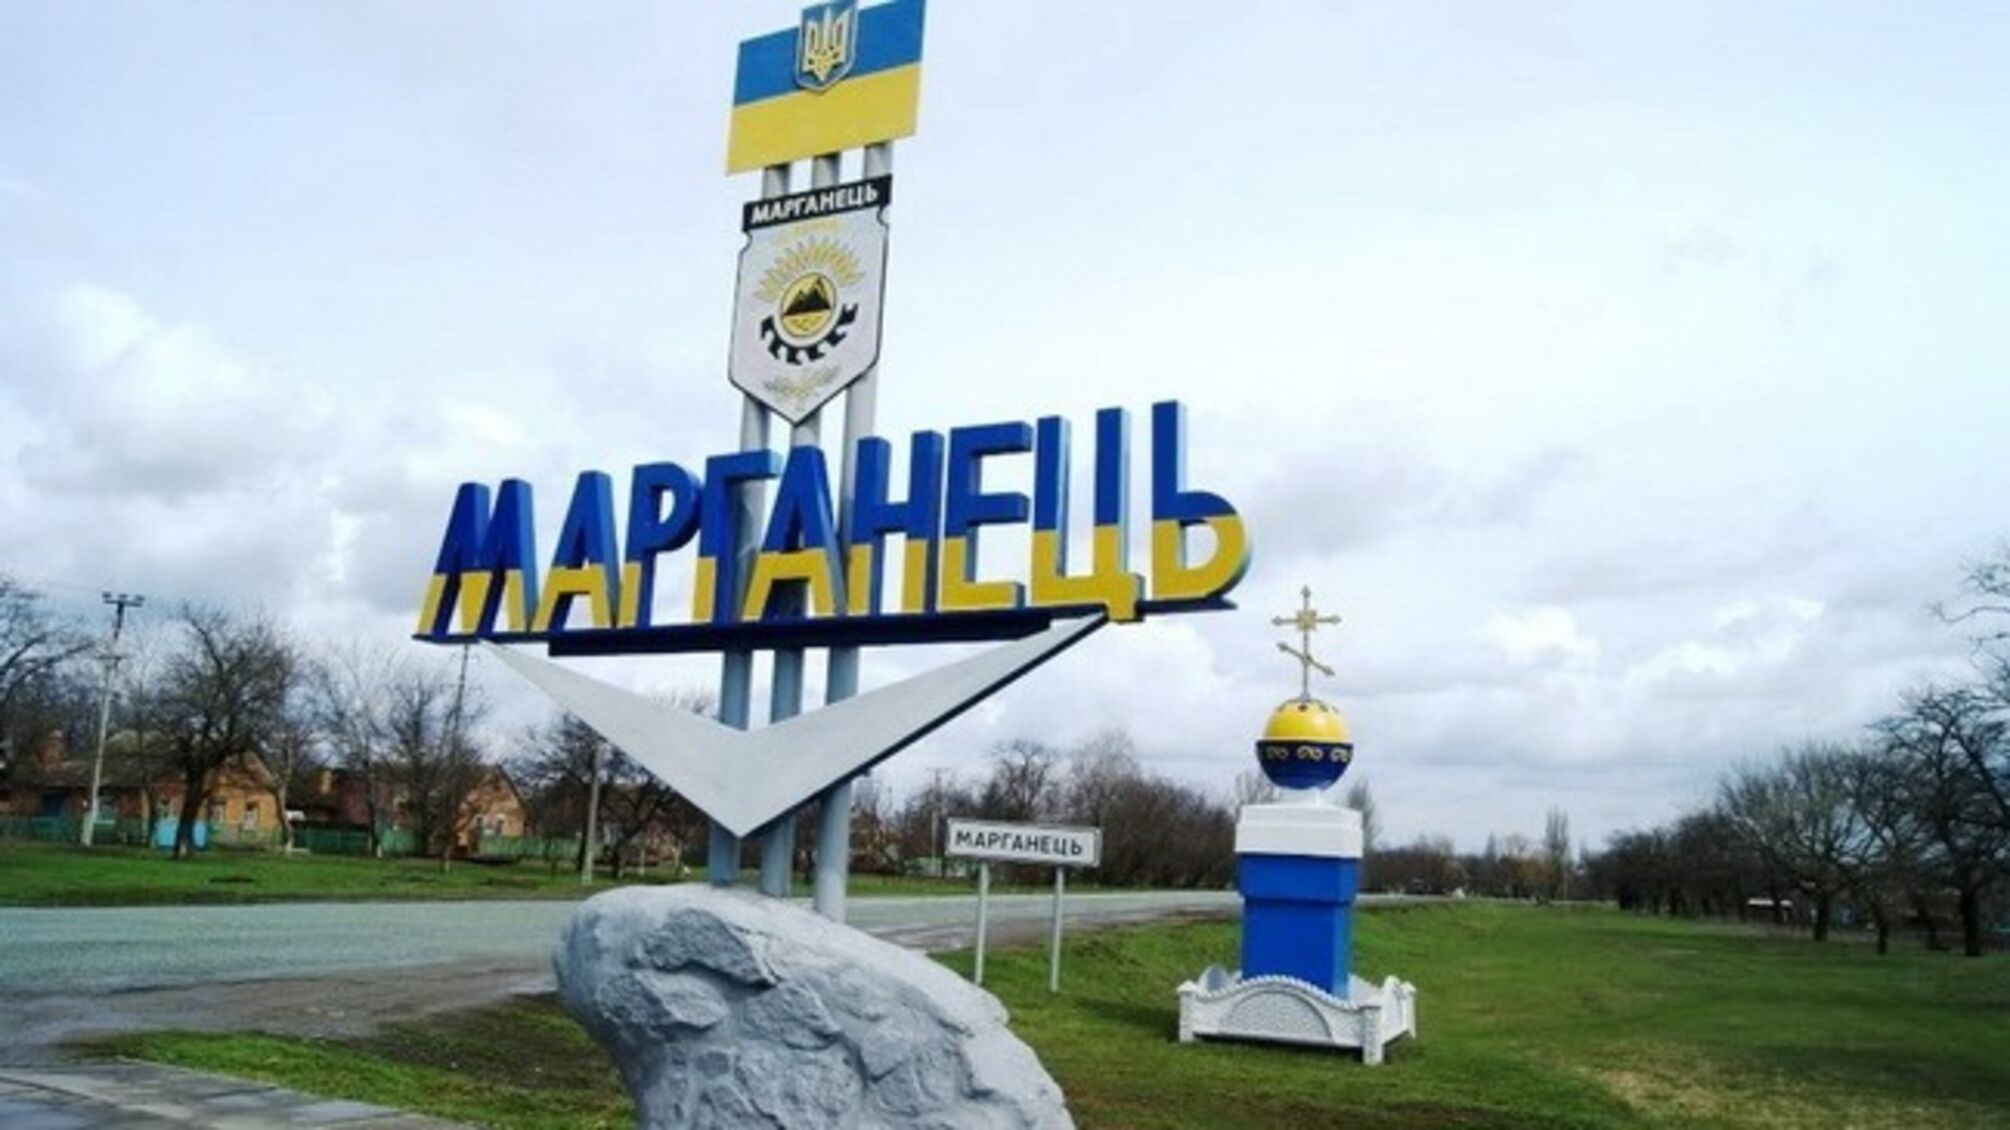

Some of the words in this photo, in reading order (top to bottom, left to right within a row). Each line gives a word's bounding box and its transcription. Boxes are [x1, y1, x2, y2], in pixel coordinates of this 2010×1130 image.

[751, 184, 879, 223] МАРГАНЕЦЬ
[416, 400, 1252, 635] МАРГАНЕЦЬ
[955, 831, 1083, 857] МАРГАНЕЦЬ
